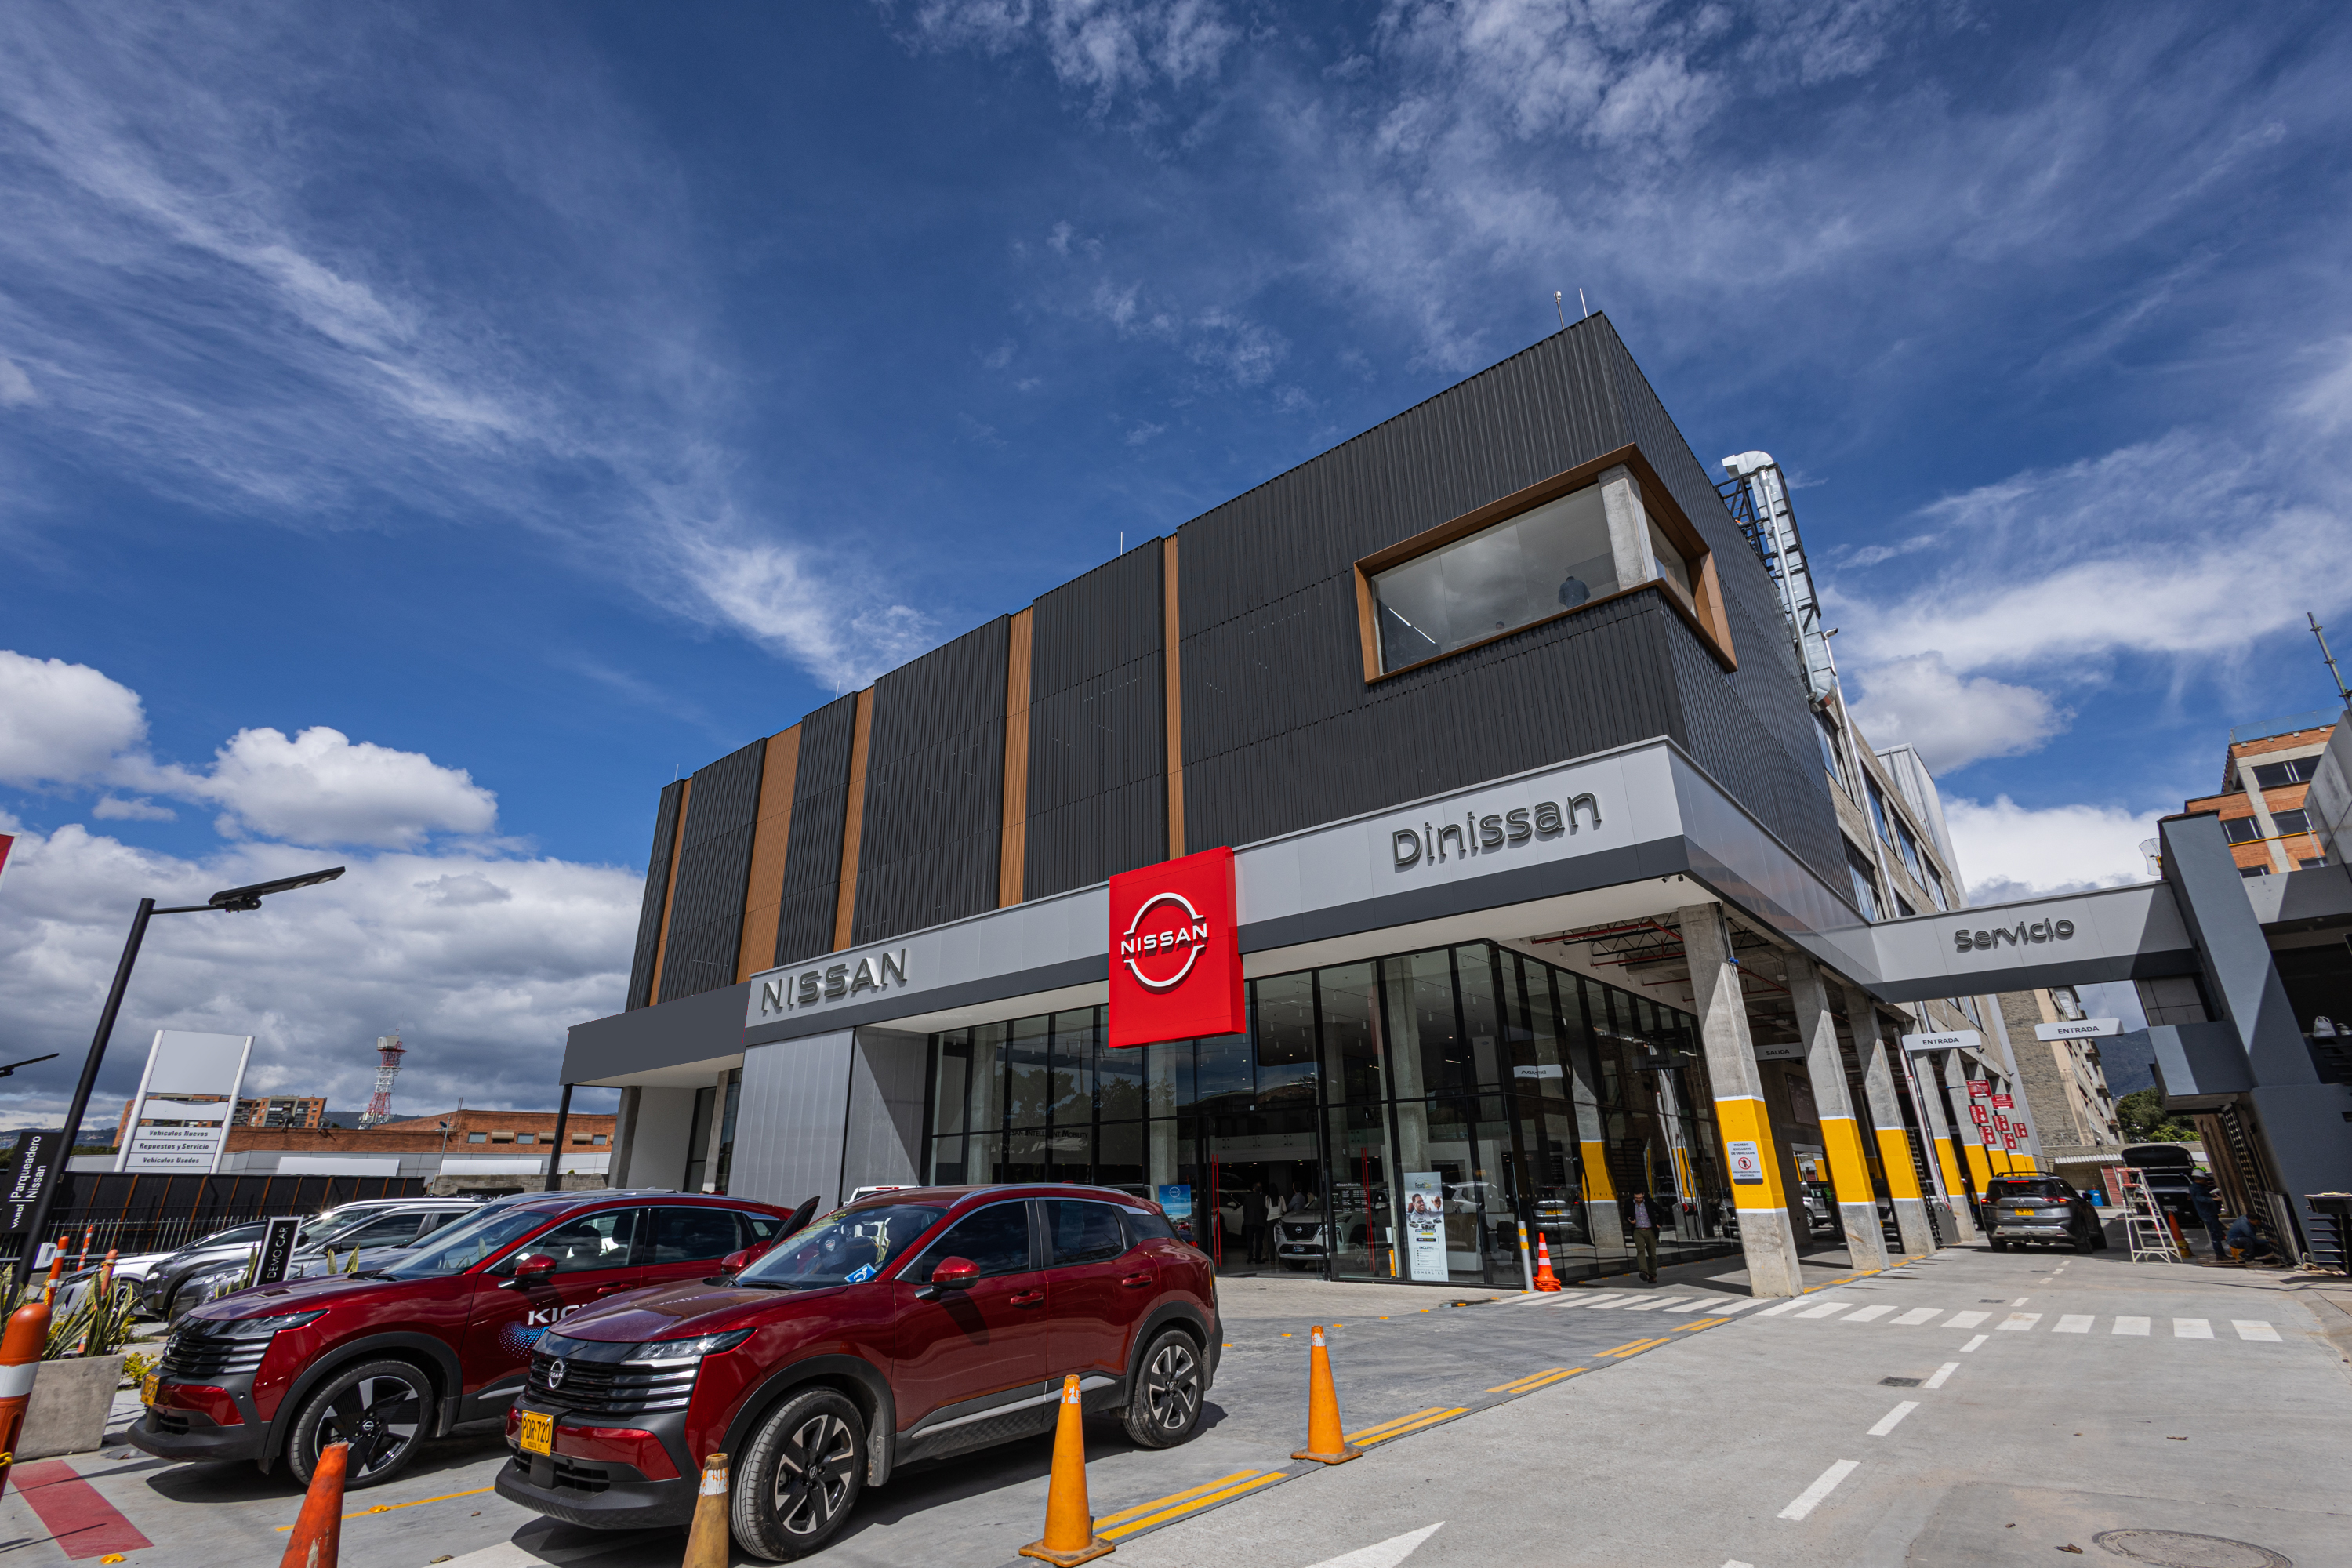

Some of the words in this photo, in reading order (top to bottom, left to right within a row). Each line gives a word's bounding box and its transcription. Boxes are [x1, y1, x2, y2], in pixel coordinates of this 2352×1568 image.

[1392, 792, 1602, 865] Dinissan
[1121, 923, 1207, 955] NISSAN
[1955, 917, 2074, 948] Servicio
[761, 948, 907, 1011] NISSAN
[2057, 1025, 2100, 1034] ENTRADA
[10, 1135, 42, 1198] Parqueadero
[25, 1165, 47, 1198] Nissan
[267, 1249, 282, 1279] DEMO
[275, 1227, 289, 1247] CAR
